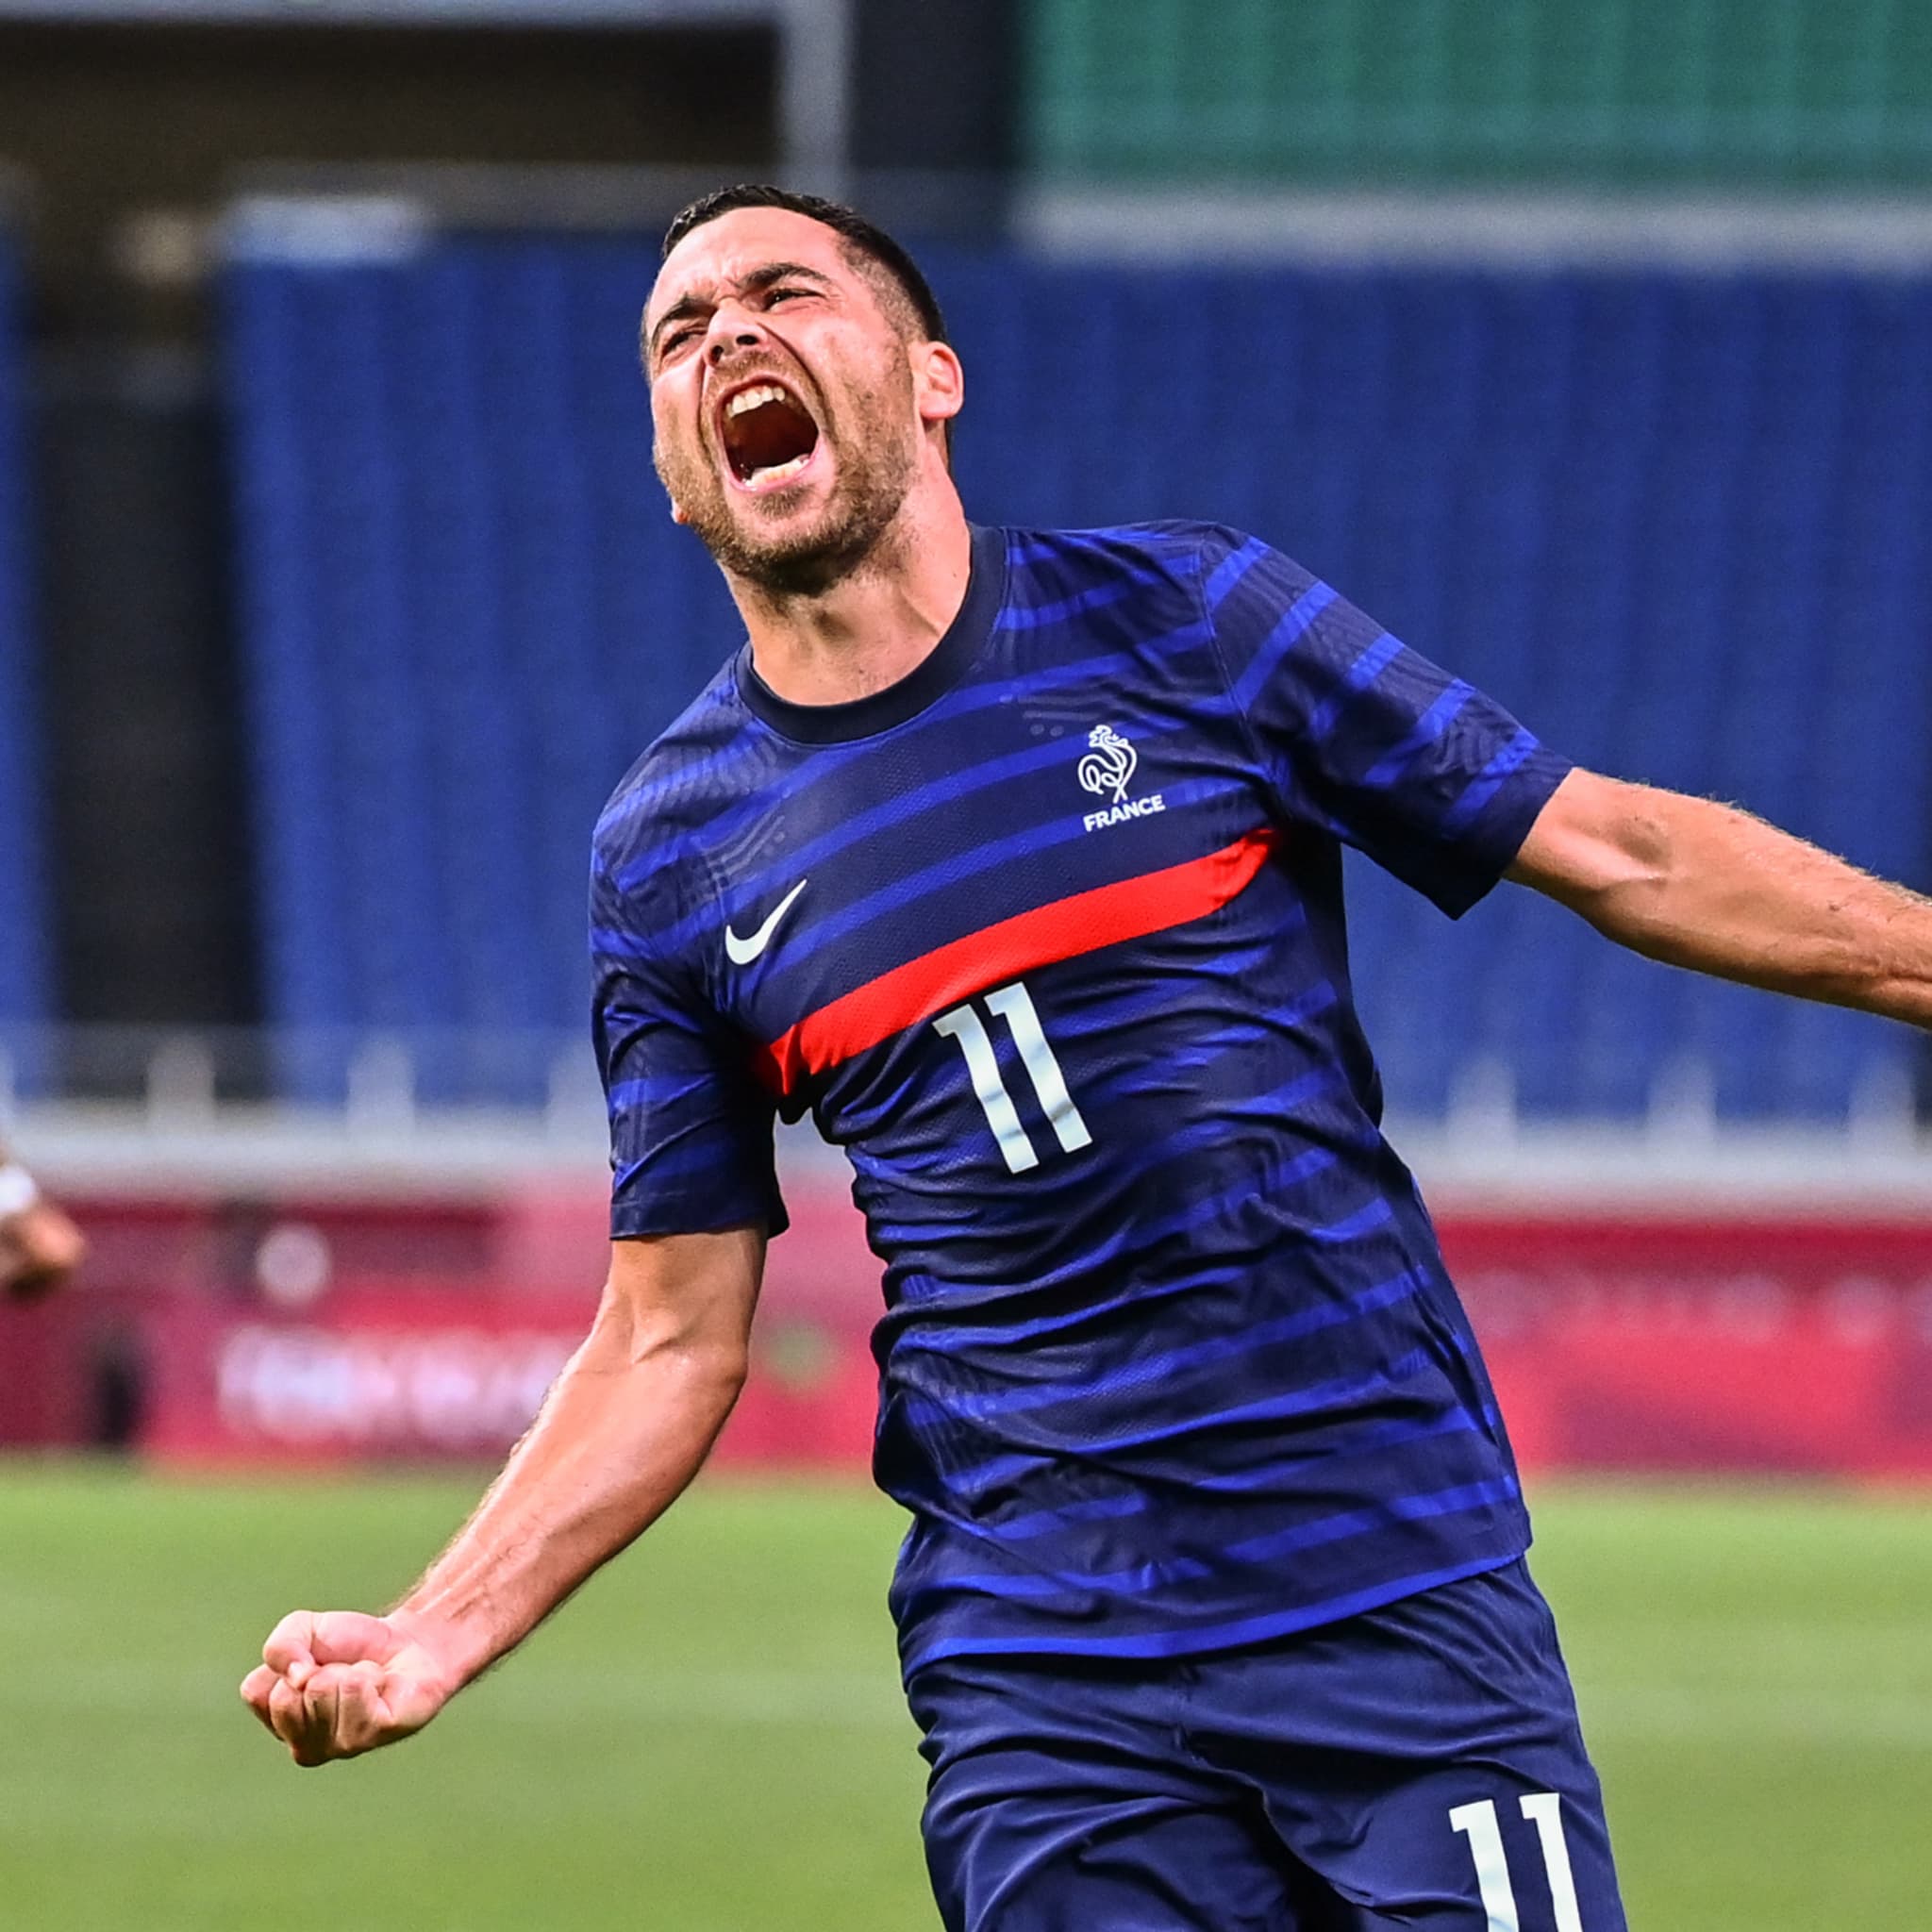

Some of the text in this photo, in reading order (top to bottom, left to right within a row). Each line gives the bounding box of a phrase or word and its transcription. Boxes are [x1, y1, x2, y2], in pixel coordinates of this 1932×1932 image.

[1083, 794, 1166, 832] FRANCE
[931, 981, 1093, 1174] 11
[1448, 1792, 1584, 1932] 11
